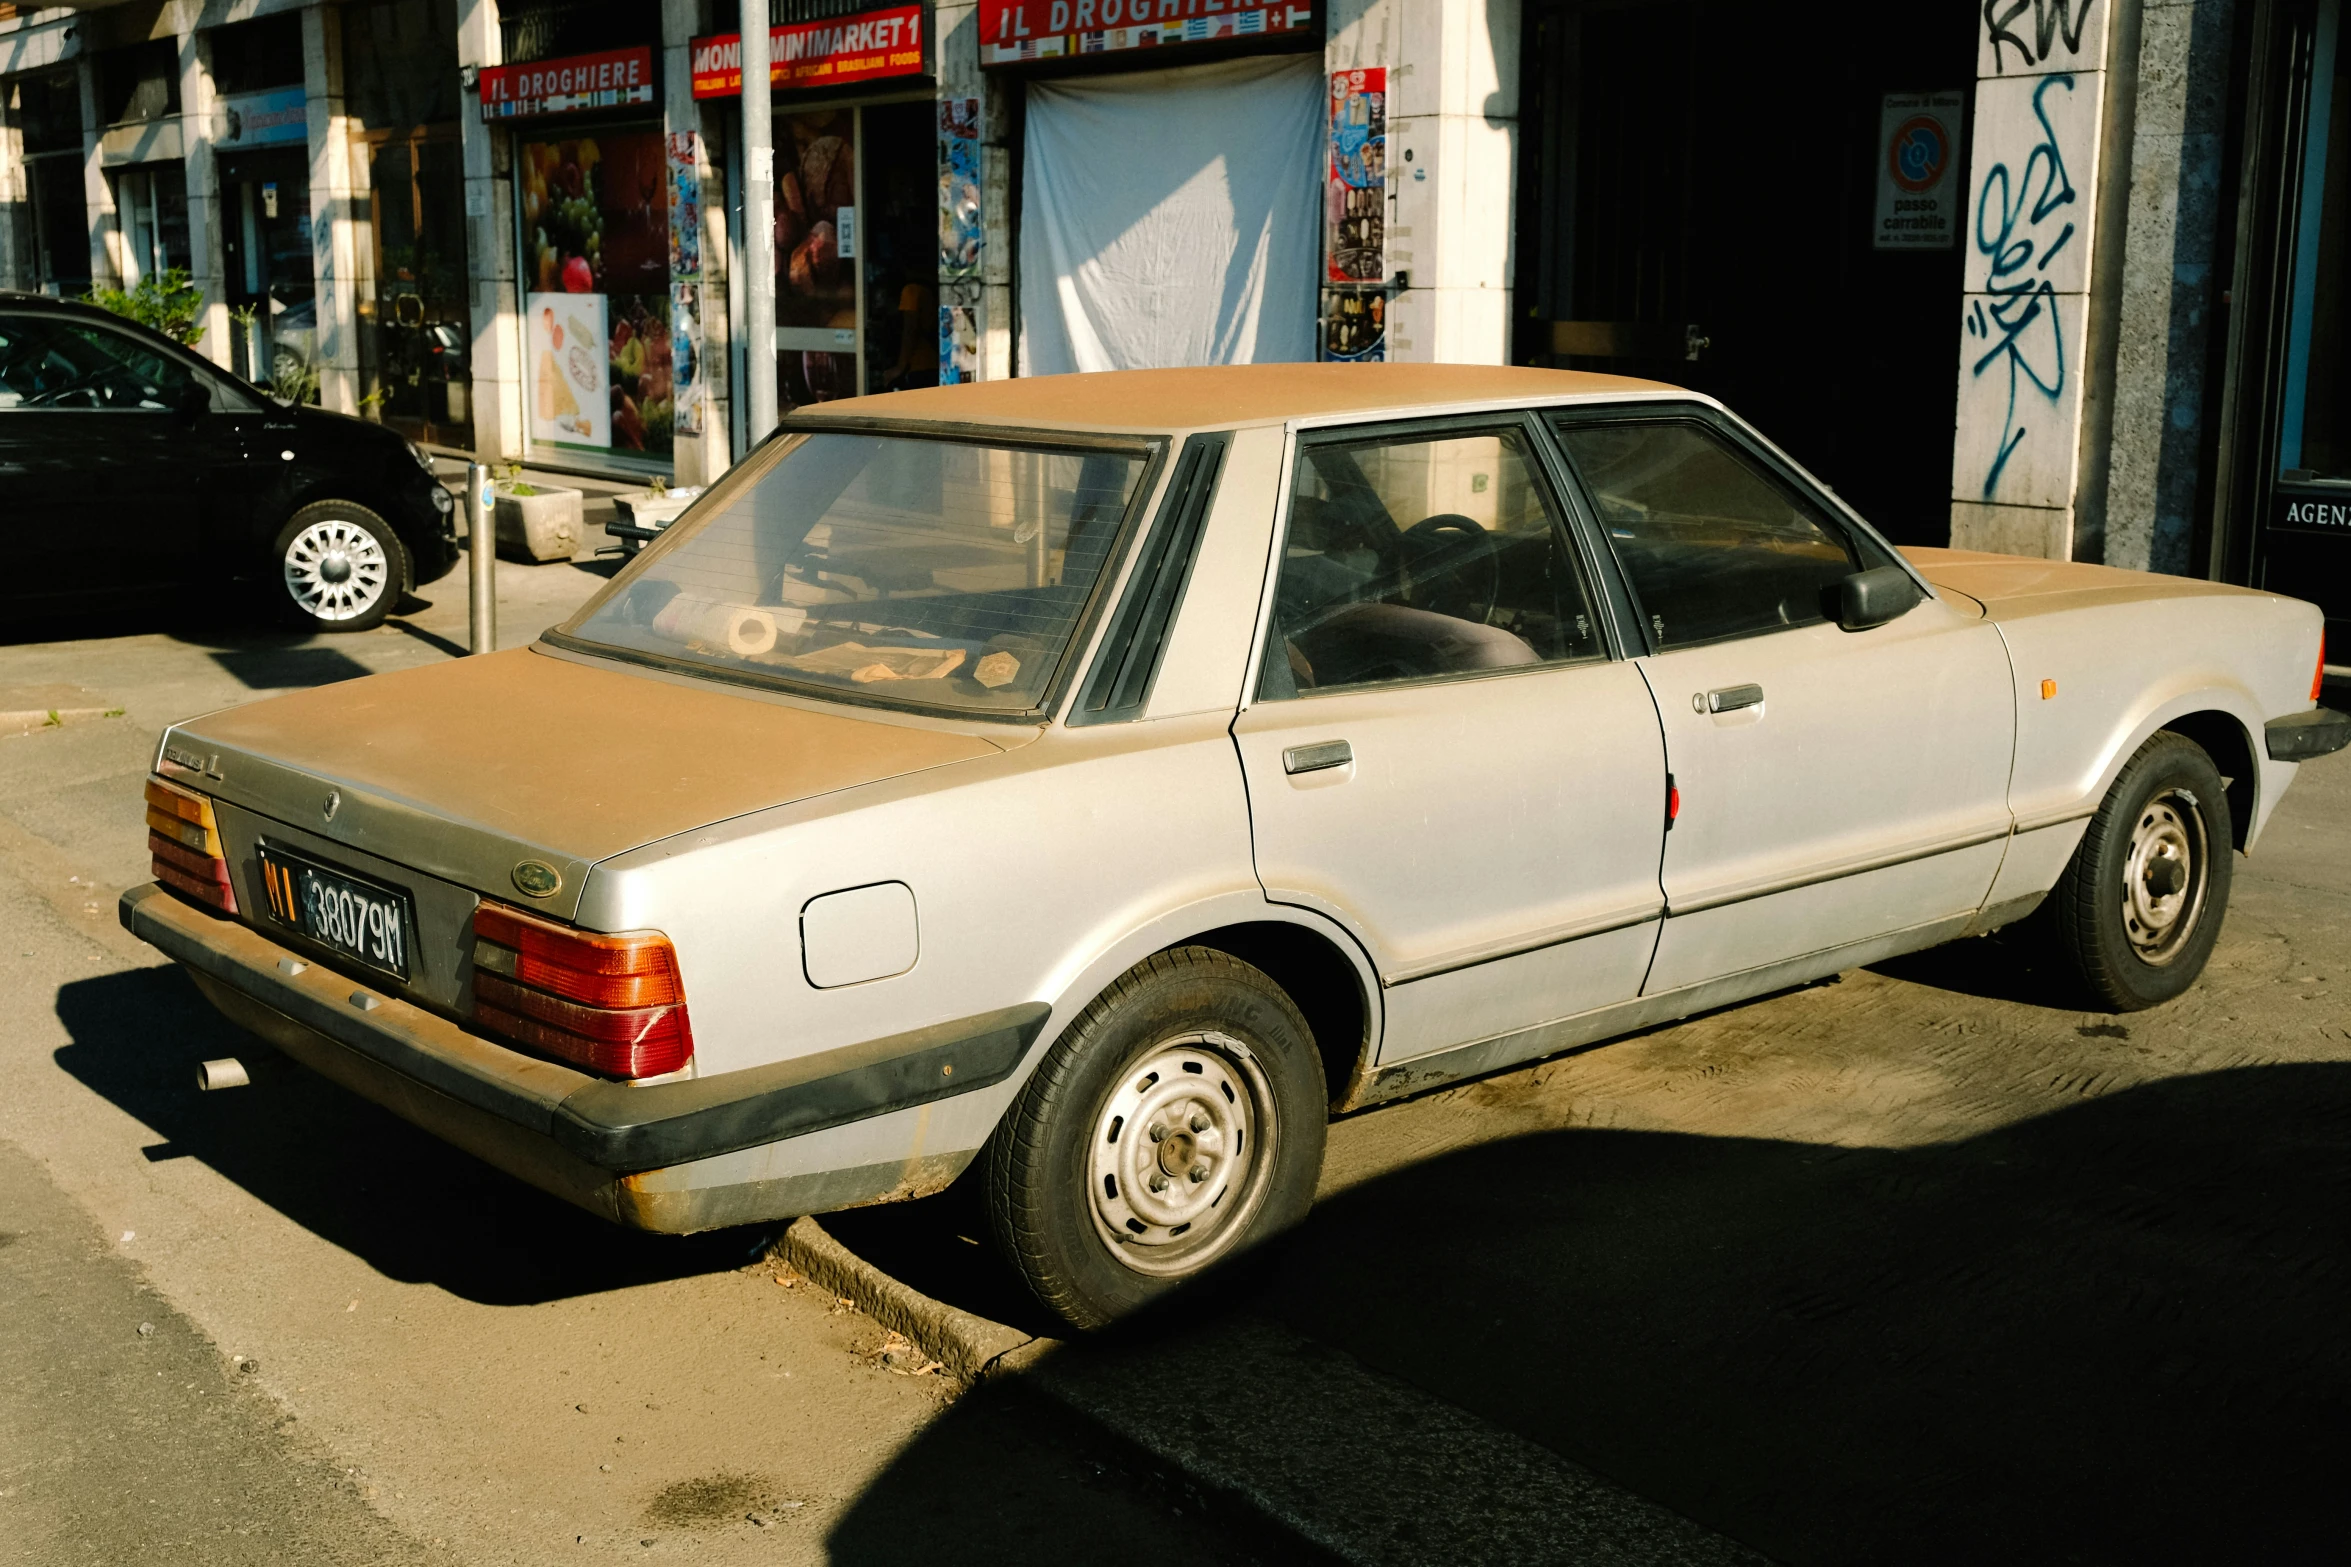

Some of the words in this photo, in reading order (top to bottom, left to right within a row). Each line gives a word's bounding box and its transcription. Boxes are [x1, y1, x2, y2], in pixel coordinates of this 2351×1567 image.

[999, 7, 1030, 39] IL
[770, 17, 904, 64] MINIMARKET
[908, 14, 919, 45] 1
[890, 51, 920, 66] FOODS
[492, 78, 509, 101] IL
[519, 60, 640, 98] DROGHIERE
[1894, 199, 1938, 215] passo
[1883, 214, 1946, 230] carrabile
[2287, 502, 2351, 526] AGEN
[264, 859, 296, 922] MI
[312, 881, 403, 967] 38079M
